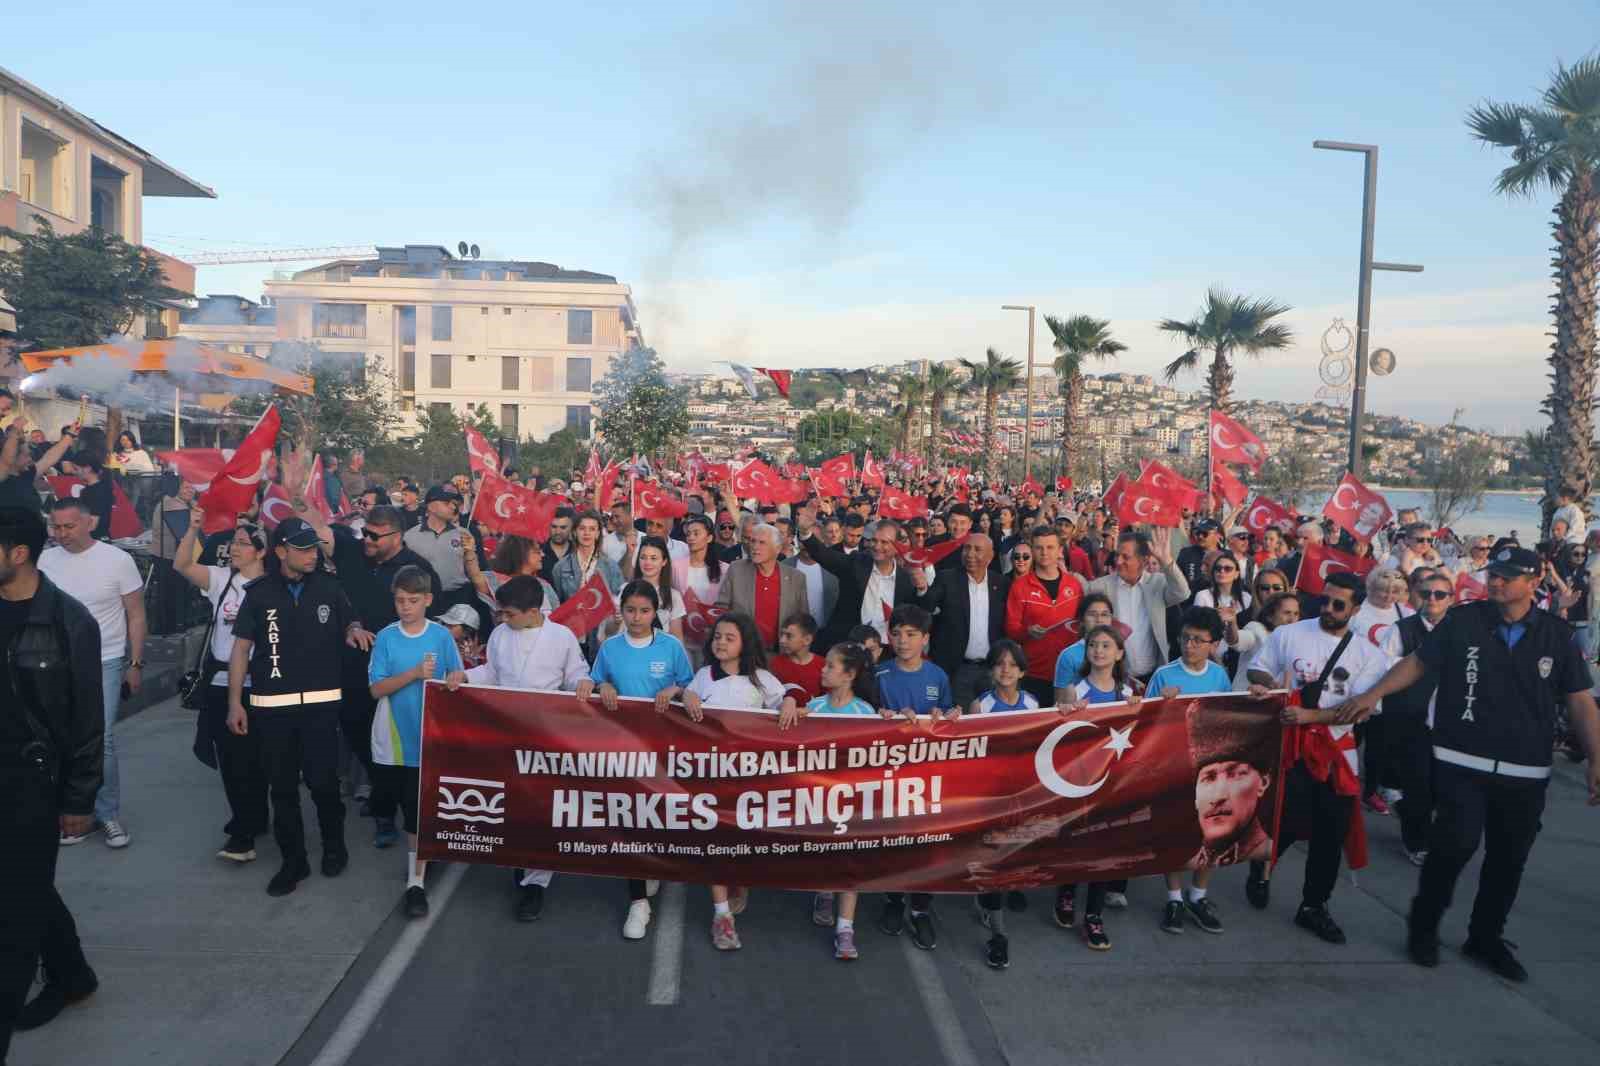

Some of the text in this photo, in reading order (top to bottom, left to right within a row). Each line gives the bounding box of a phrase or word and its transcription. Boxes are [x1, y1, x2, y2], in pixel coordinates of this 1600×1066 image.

[266, 608, 282, 679] ZABITA
[1461, 646, 1480, 721] ZABITA
[515, 736, 989, 778] VATANININ İSTİKBALİNİ DÜŞÜNEN
[551, 769, 942, 835] HERKES GENÇTİR!
[436, 830, 504, 845] BÜYÜKÇEKMECE
[447, 841, 493, 853] BELEDİYESİ
[557, 832, 953, 858] 19 Mayıs Atatürk'ü Anma, Gençlik ve Spor Bayramı'mız kutlu olsun.
